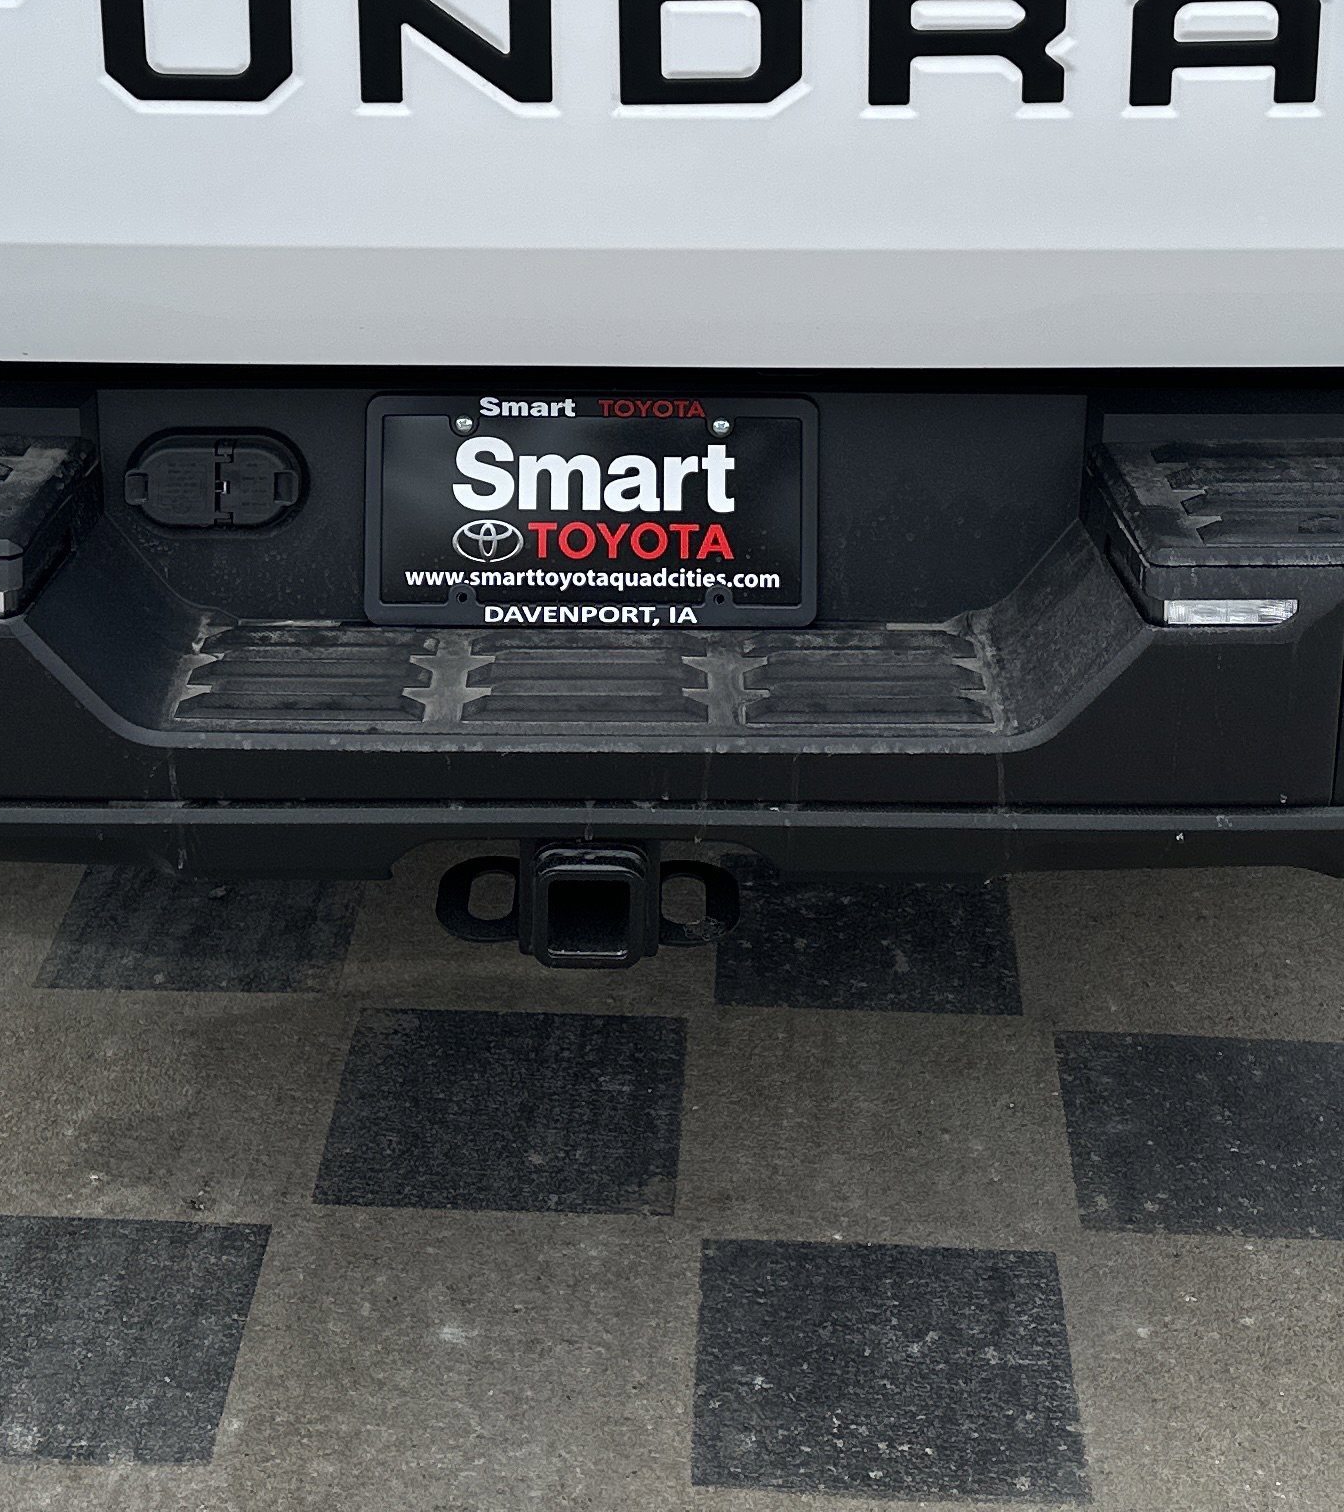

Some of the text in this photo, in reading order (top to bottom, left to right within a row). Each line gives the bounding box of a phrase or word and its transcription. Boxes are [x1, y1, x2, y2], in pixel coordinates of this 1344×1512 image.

[479, 396, 706, 419] Smart TOYOTA
[452, 436, 736, 513] Smart
[528, 521, 735, 560] TOYOTA
[404, 567, 781, 592] www.smarttoyotaquadcities.com
[484, 605, 698, 627] DAVENPORT, IA
